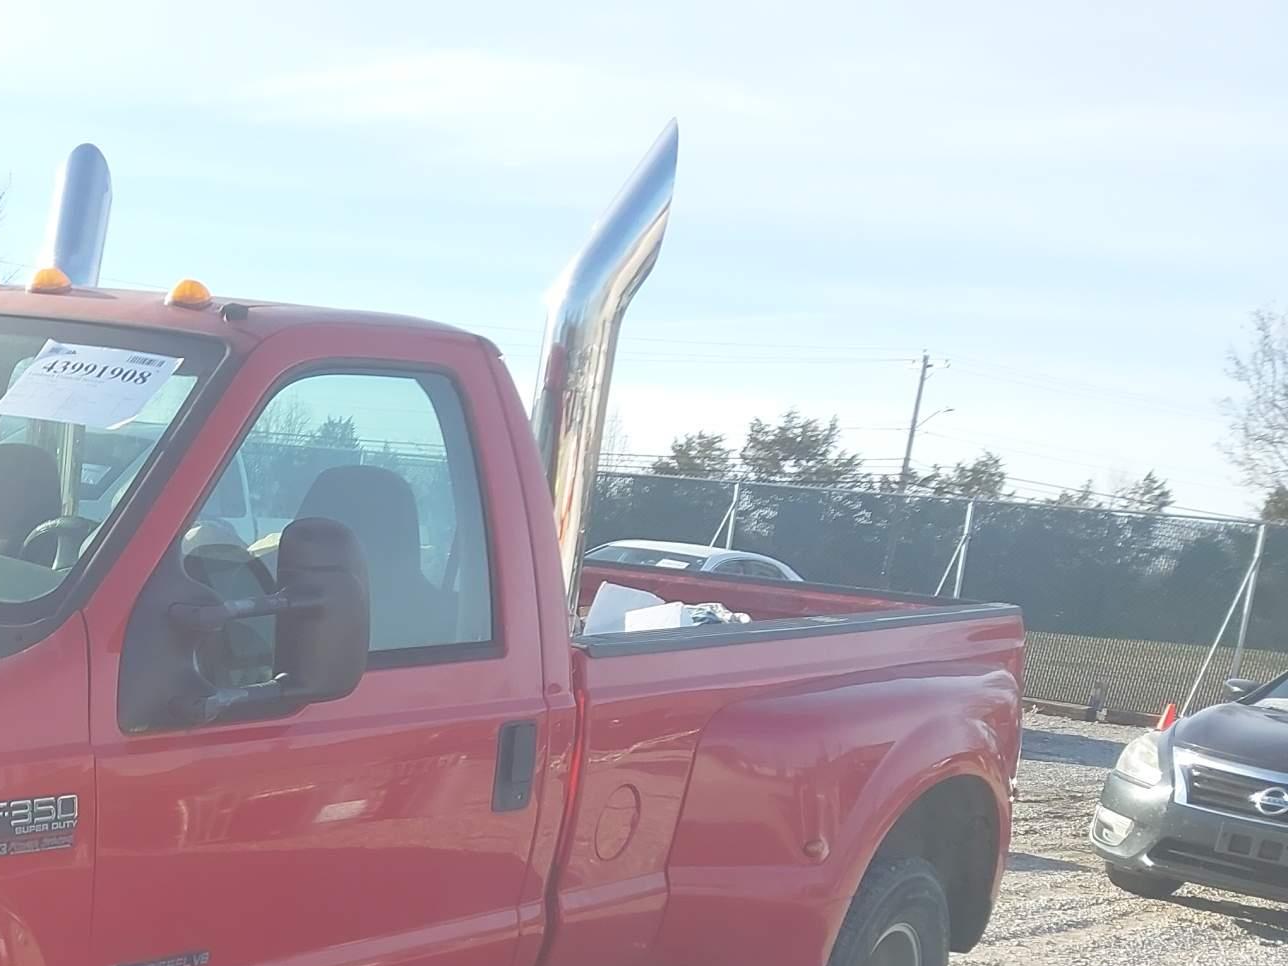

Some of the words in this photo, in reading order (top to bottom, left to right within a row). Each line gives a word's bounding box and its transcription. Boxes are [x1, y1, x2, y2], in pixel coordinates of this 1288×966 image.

[42, 359, 152, 385] 43991908
[14, 822, 49, 835] SUPER
[51, 819, 78, 831] DUTY
